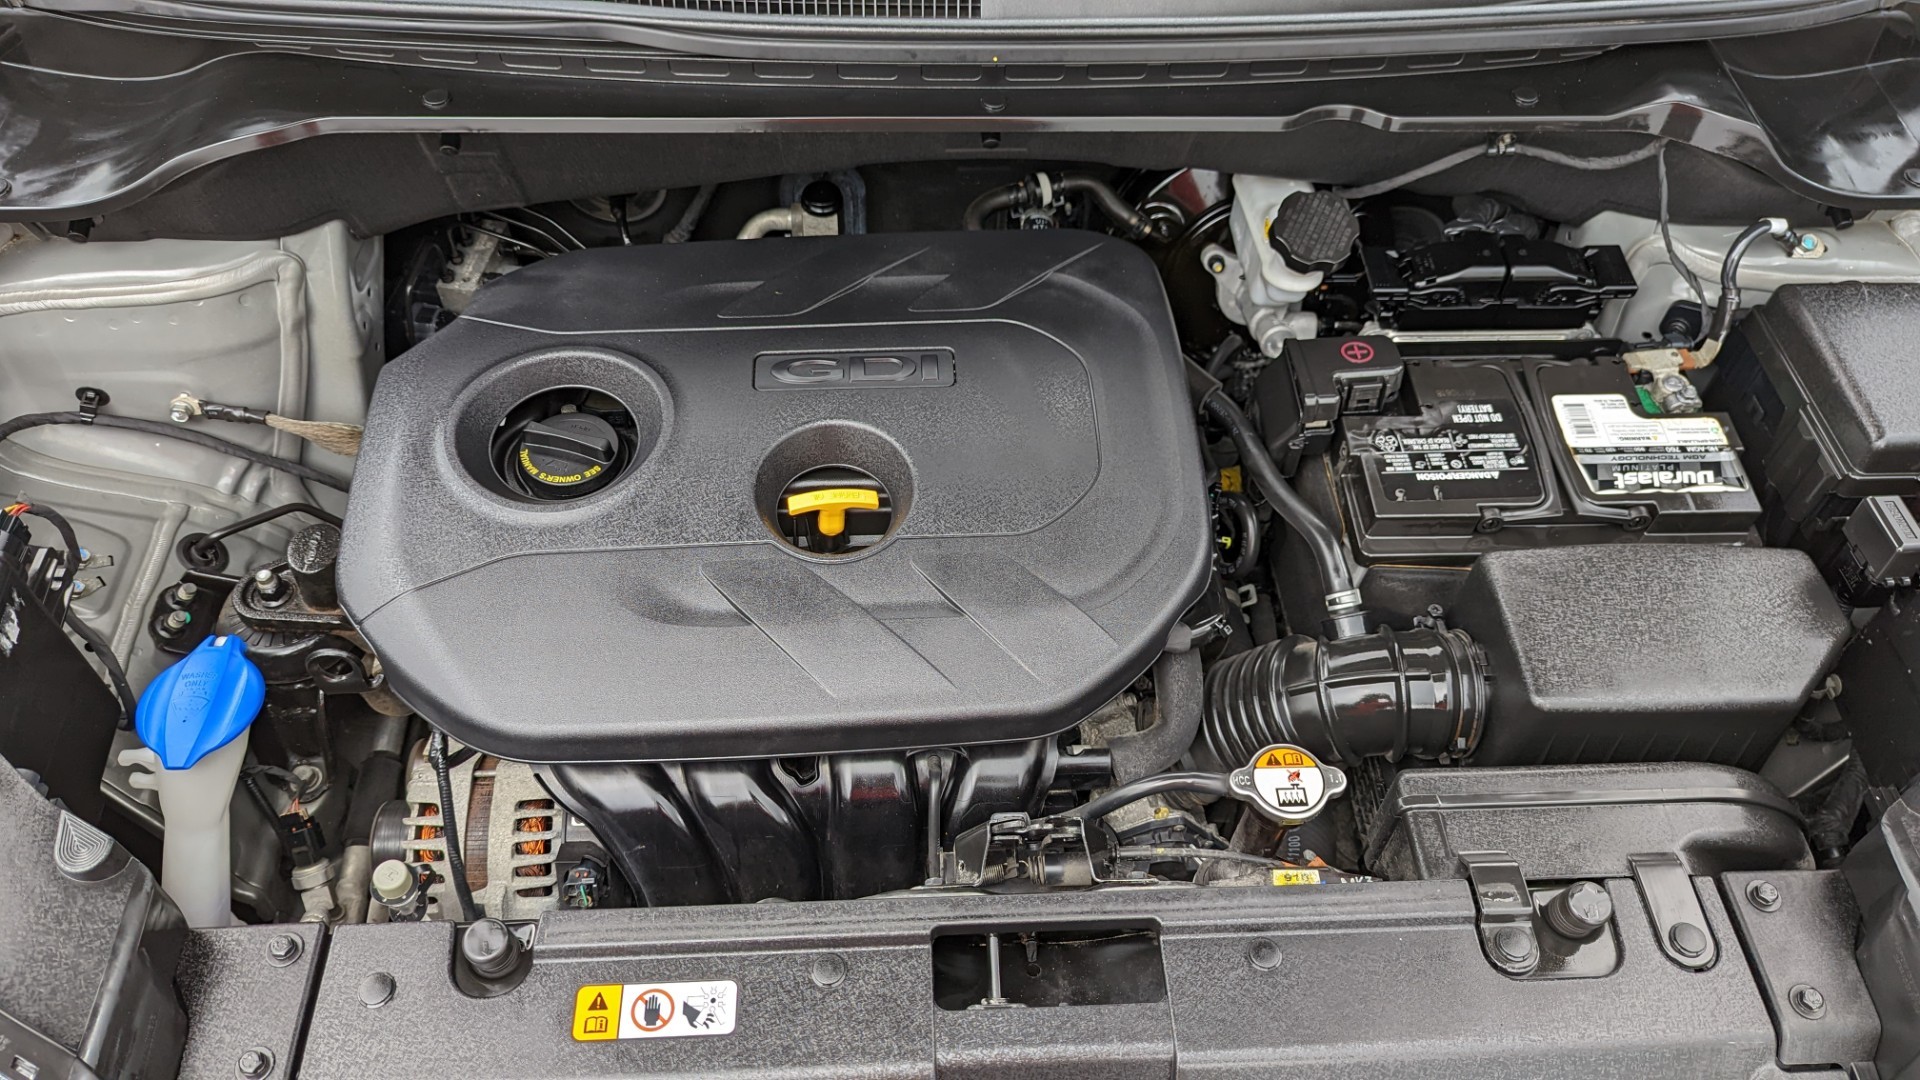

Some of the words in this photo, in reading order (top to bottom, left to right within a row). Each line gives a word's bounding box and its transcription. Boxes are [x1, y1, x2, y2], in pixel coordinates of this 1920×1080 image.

[770, 353, 940, 385] GDI
[1457, 404, 1493, 413] BATTERY!
[1452, 414, 1473, 423] OPEN
[1474, 413, 1490, 422] NOT
[1490, 413, 1503, 422] DO
[519, 448, 540, 475] MANUAL
[583, 464, 602, 478] SEE
[1612, 463, 1674, 471] PLATINUM
[538, 472, 582, 483] OWNER'S
[1613, 469, 1722, 488] Duralast
[184, 680, 209, 688] ONLY
[1232, 774, 1251, 786] HCC
